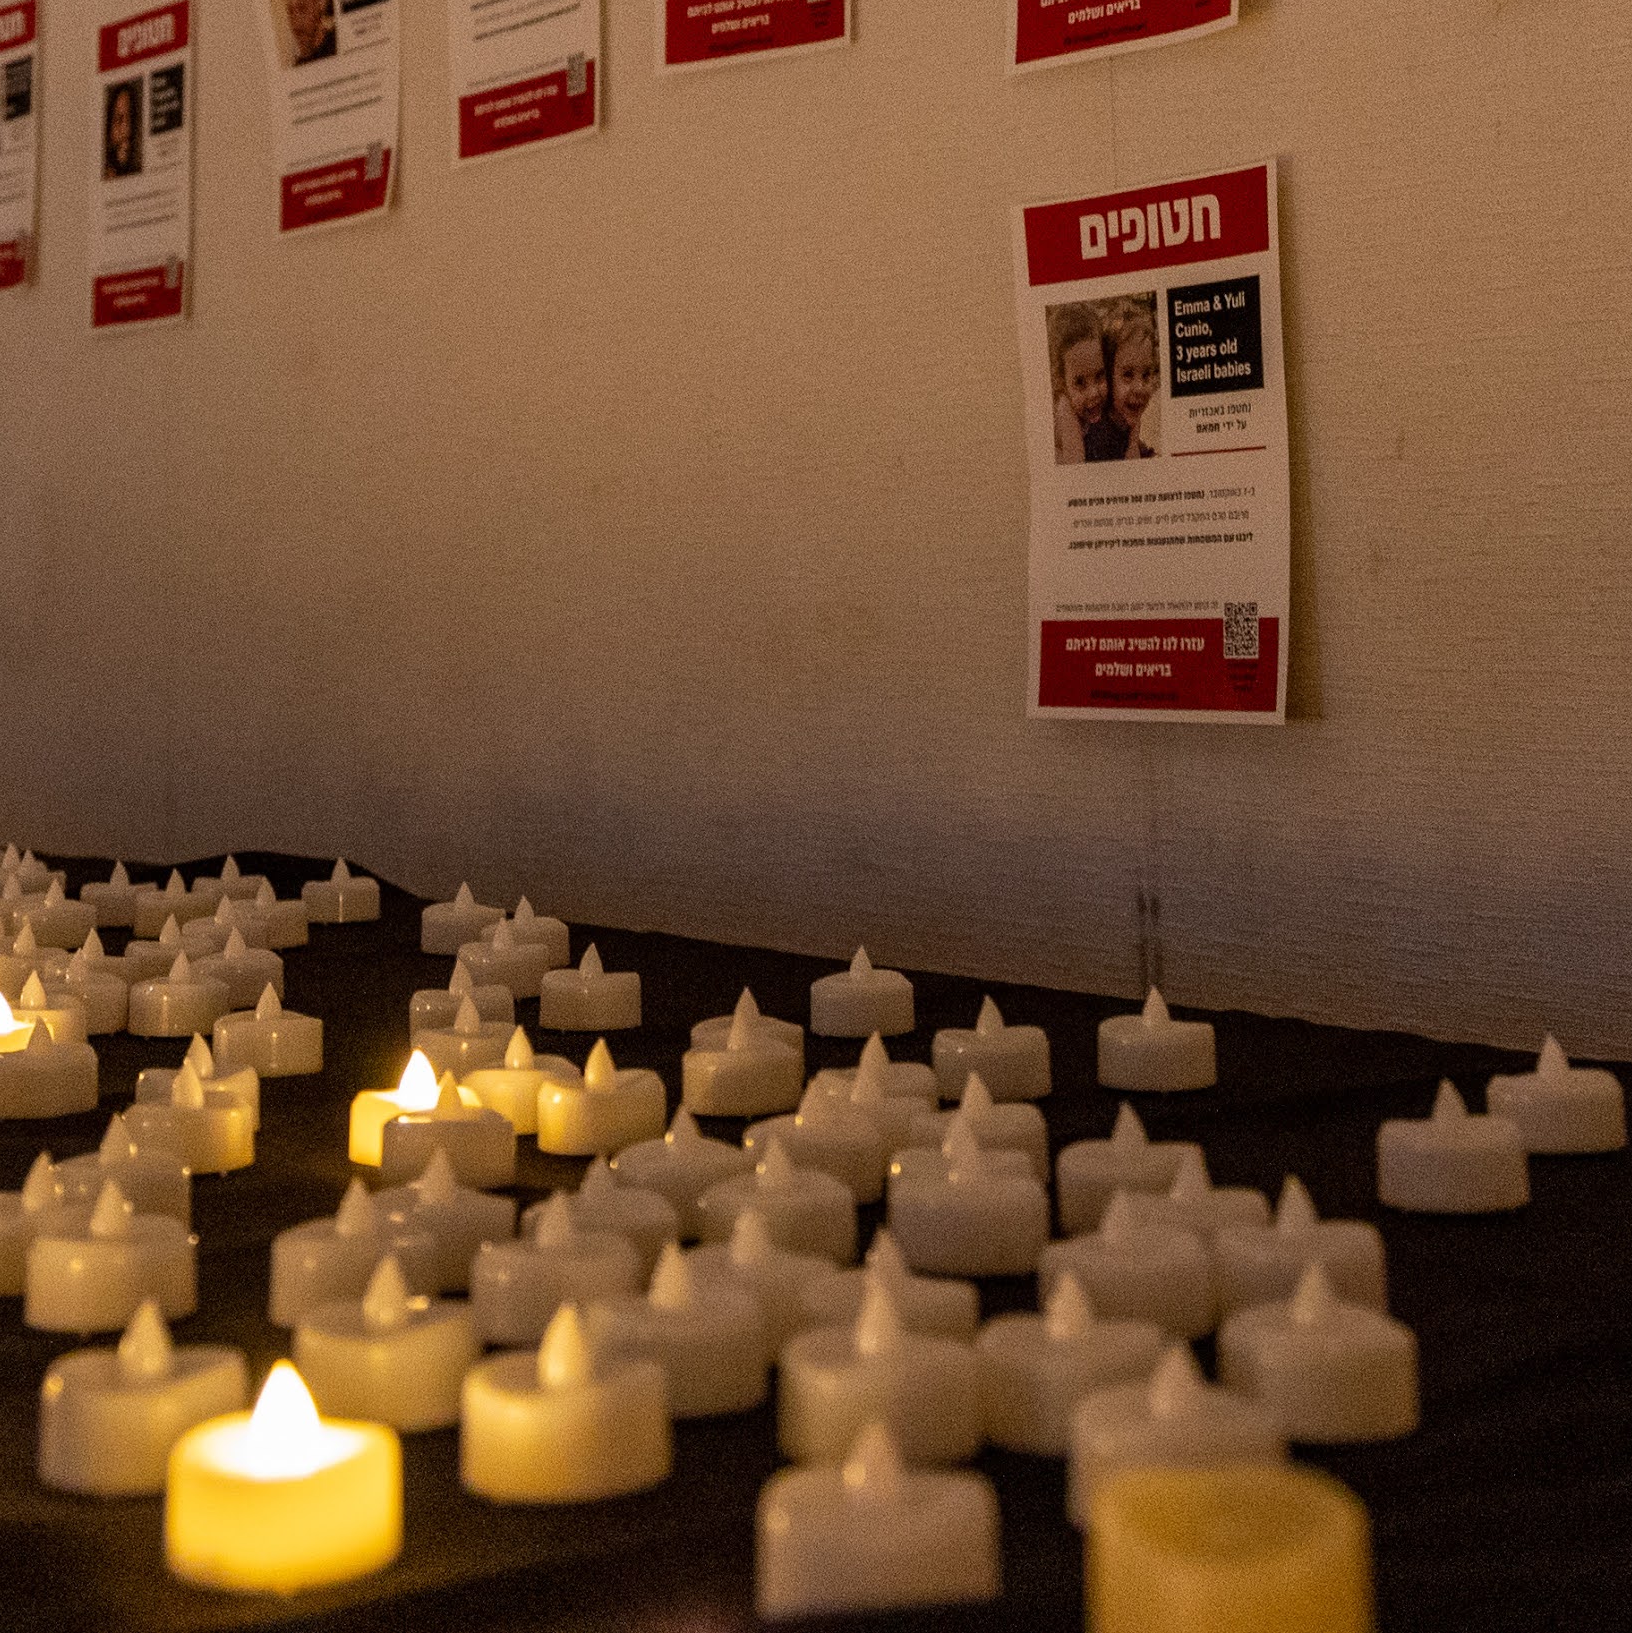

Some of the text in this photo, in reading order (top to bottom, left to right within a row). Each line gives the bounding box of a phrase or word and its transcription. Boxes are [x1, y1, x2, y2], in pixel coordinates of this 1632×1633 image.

[1078, 193, 1221, 260] חטופים
[1173, 290, 1246, 316] Emma & Yuli
[1174, 319, 1213, 338] Cunio,
[1175, 337, 1238, 363] 3 years old
[1175, 360, 1252, 382] Israeli babies
